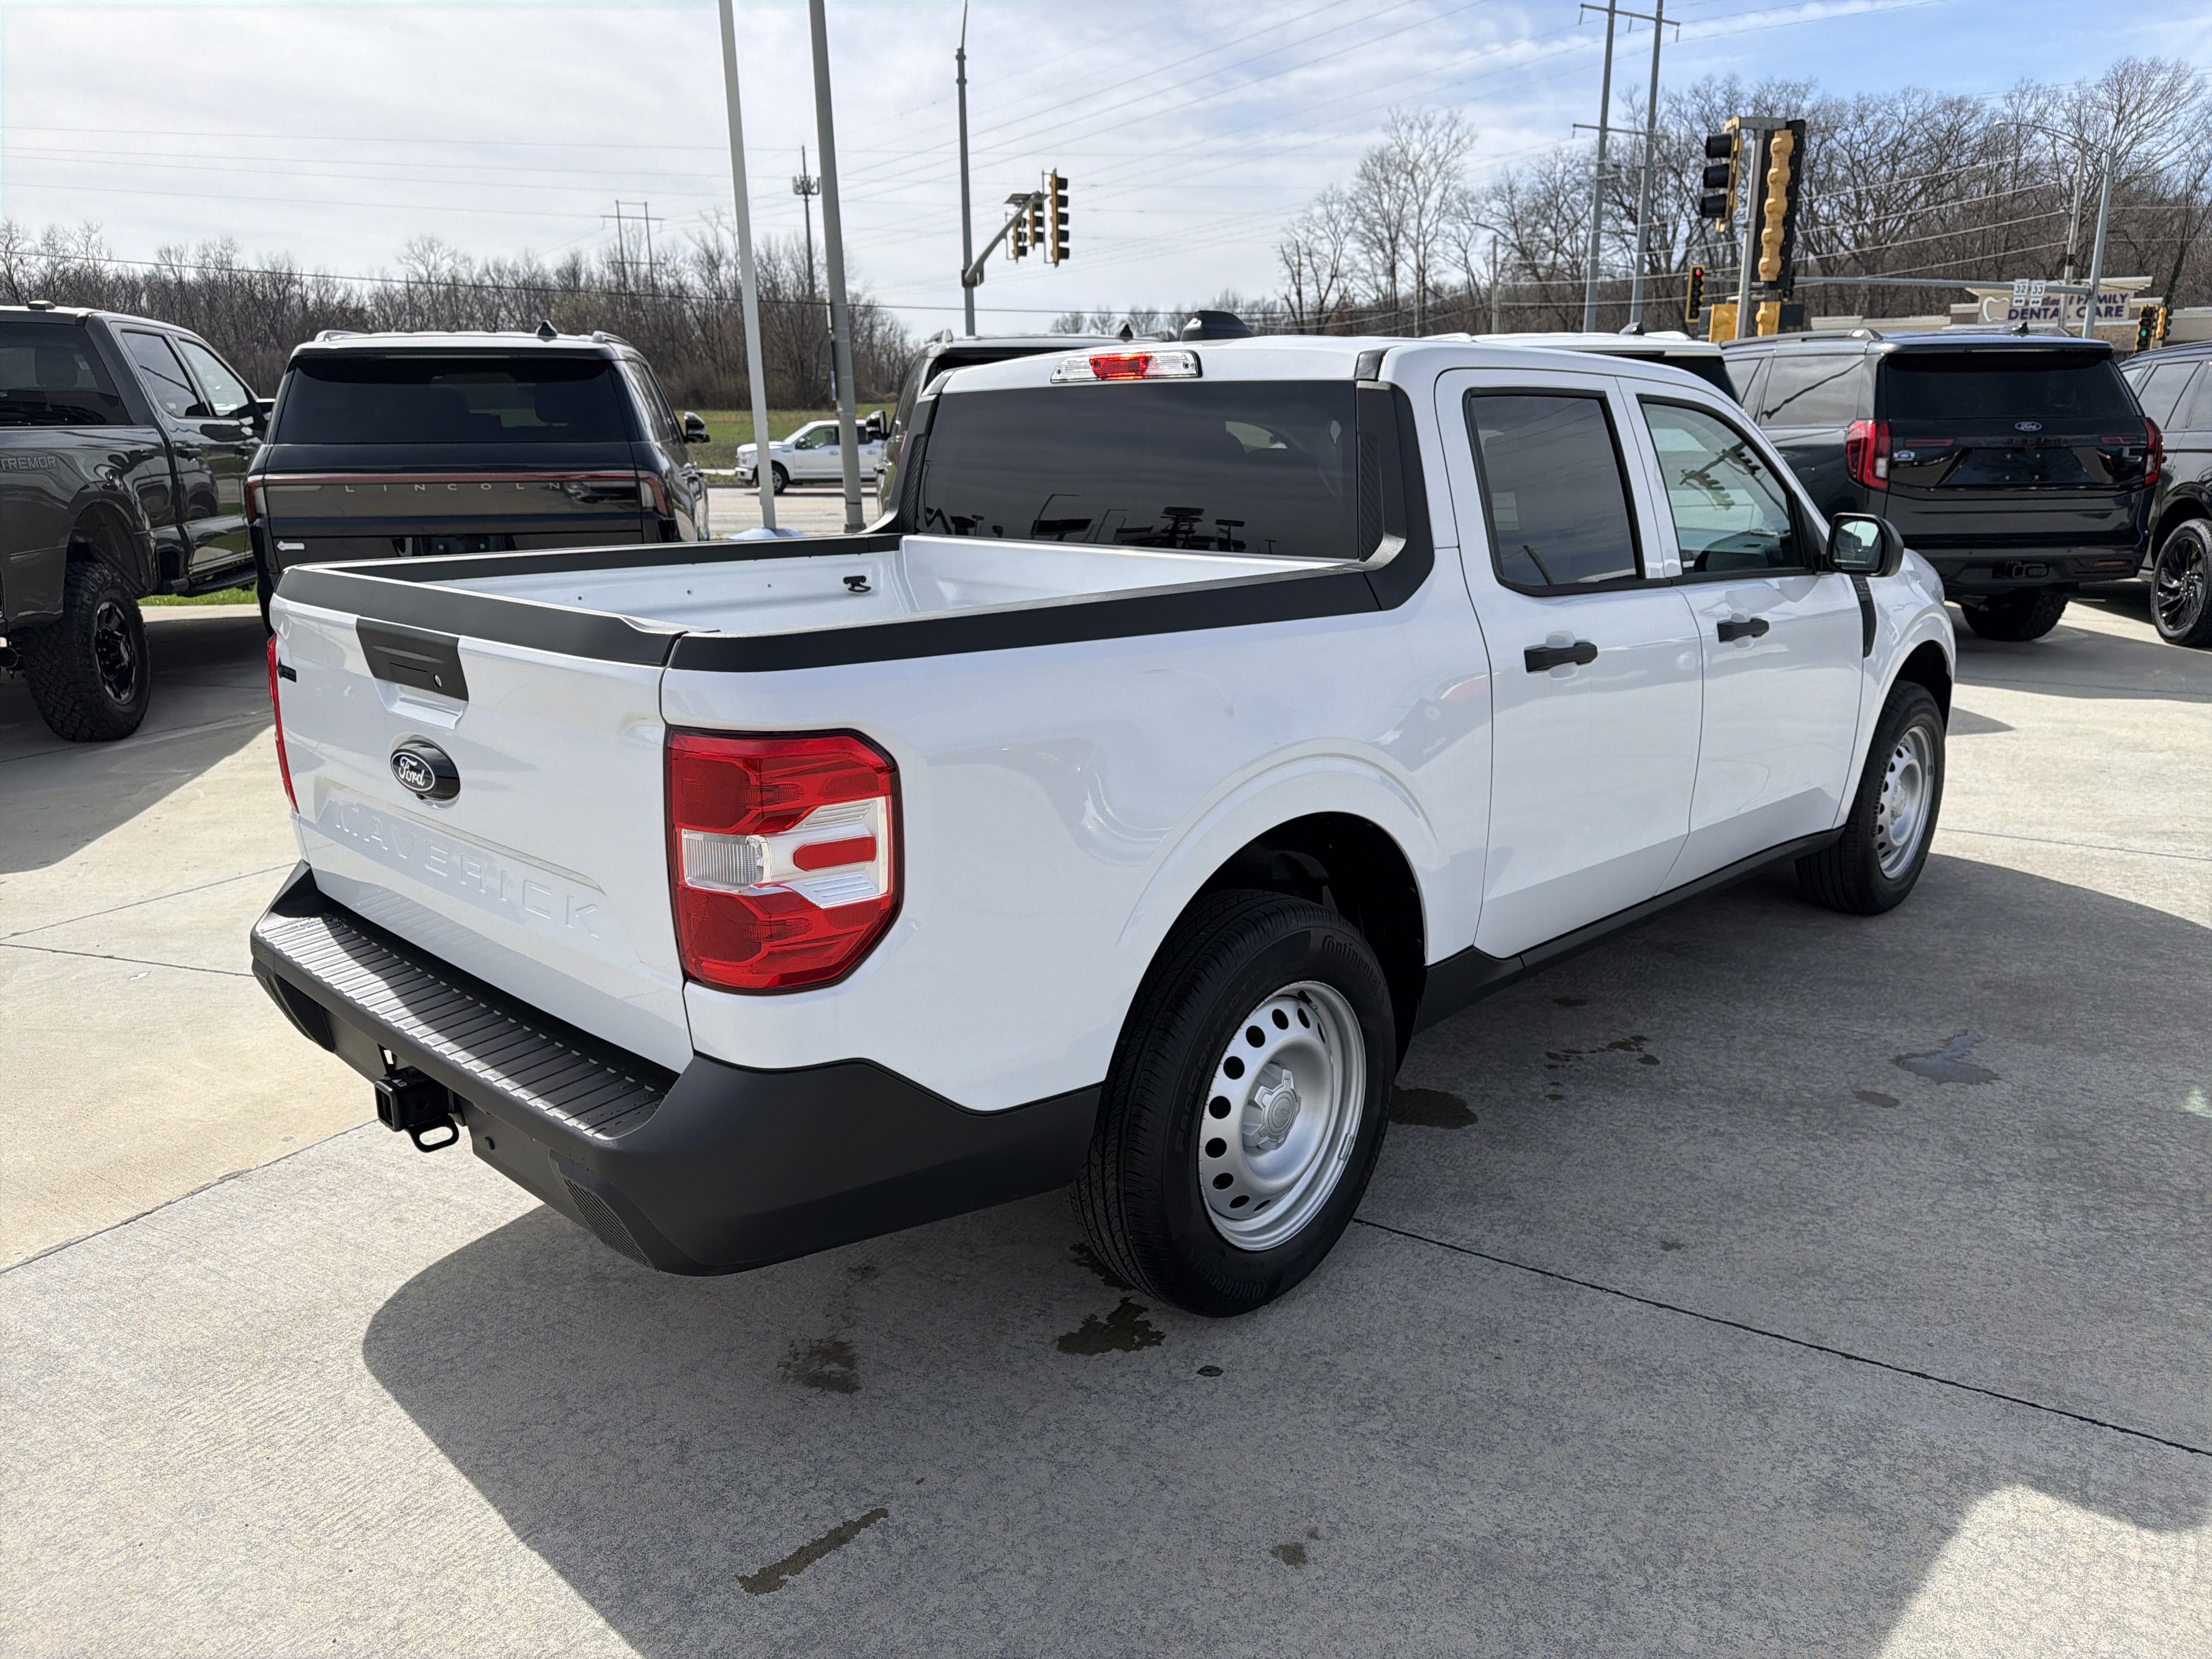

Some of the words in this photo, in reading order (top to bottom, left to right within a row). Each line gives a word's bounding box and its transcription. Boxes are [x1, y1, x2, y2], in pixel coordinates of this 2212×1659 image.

[2015, 285, 2026, 294] 32
[2032, 286, 2043, 295] 33
[2008, 307, 2070, 320] DENTA
[1, 456, 58, 471] TREMOR
[345, 482, 560, 493] LINCOLN
[398, 756, 425, 787] Ford
[332, 802, 601, 940] MAVERICK
[1321, 934, 1382, 994] Continental
